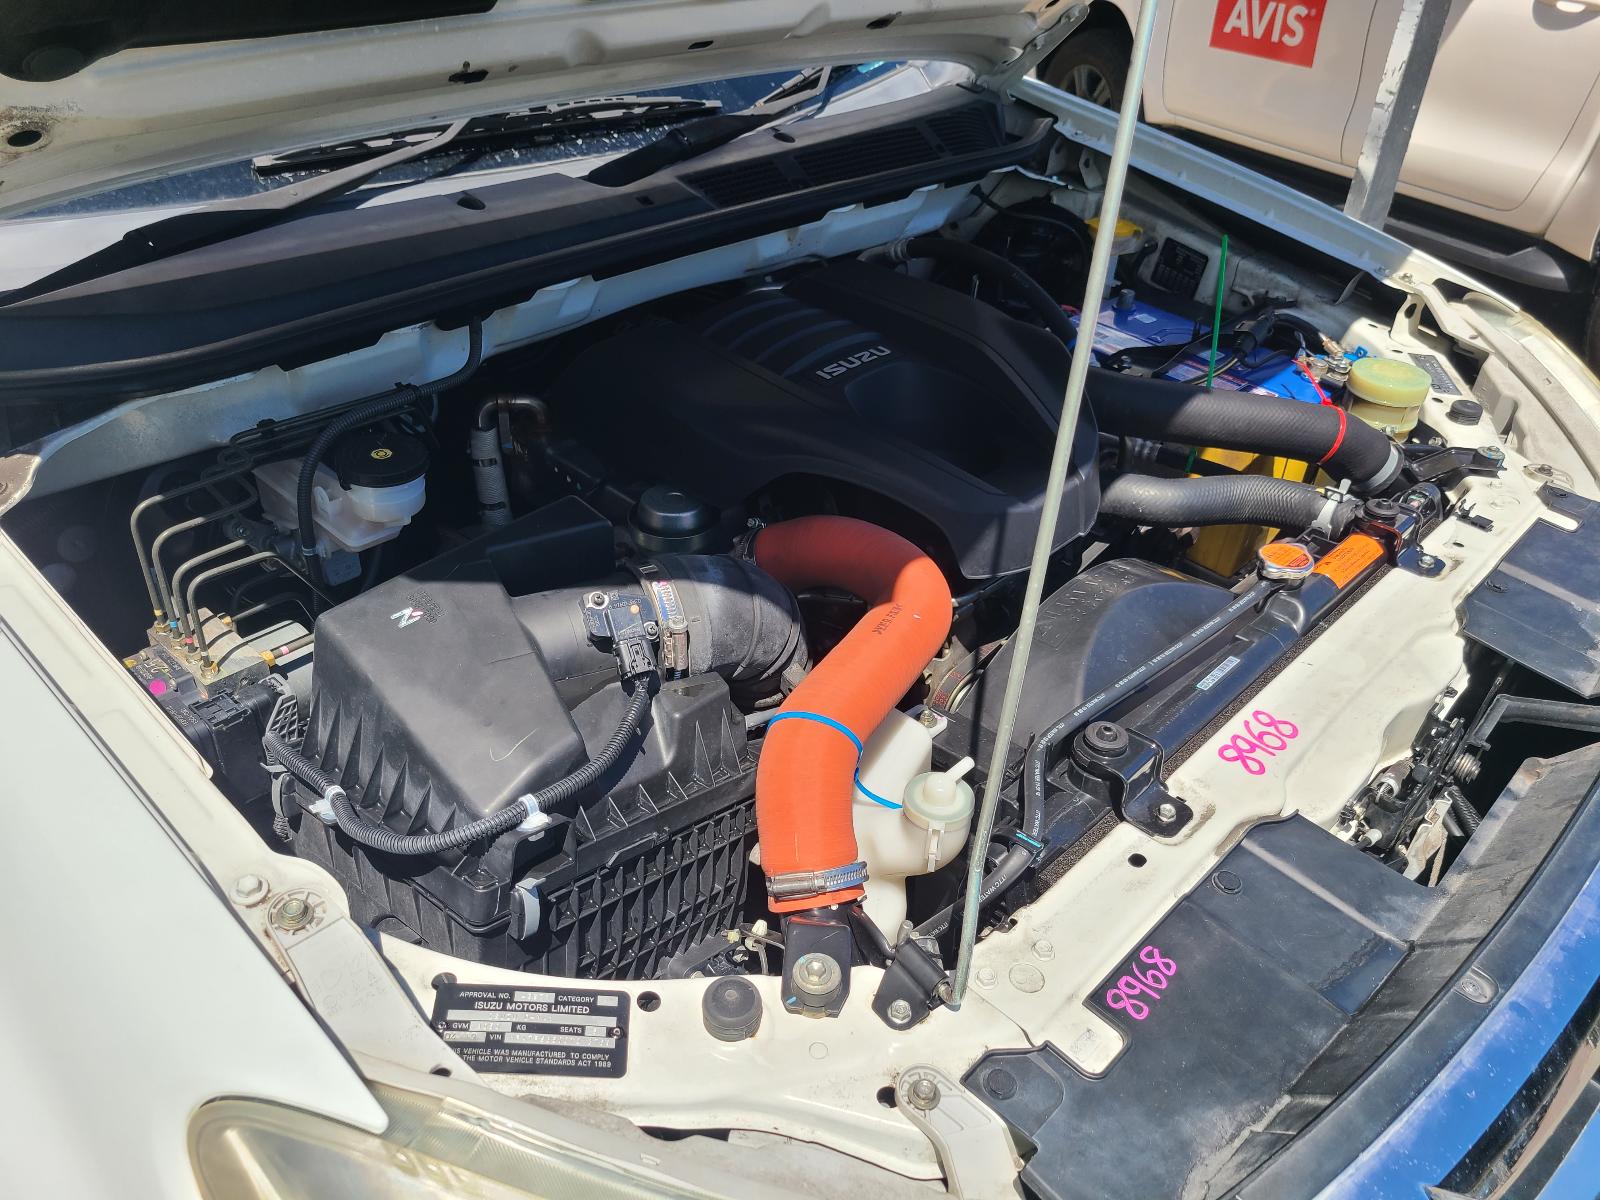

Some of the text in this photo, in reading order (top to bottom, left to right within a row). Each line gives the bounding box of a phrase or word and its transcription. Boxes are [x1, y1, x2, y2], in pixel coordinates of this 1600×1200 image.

[1222, 0, 1305, 48] AVIS
[815, 345, 892, 380] ISUZU
[1217, 709, 1300, 776] 8968
[1105, 944, 1178, 1021] 8968
[459, 991, 497, 999] APPROVAL
[558, 995, 595, 1003] CATEGORY
[474, 1001, 590, 1014] ISUZU MOTORS LIMITED
[560, 1026, 582, 1034] SEATS
[462, 1054, 475, 1062] THE
[478, 1055, 503, 1063] MOTOR
[505, 1056, 534, 1064] VEHICLE
[535, 1057, 576, 1066] STANDARDS
[577, 1060, 591, 1068] ACT
[463, 1047, 492, 1055] VEHICLE
[494, 1048, 510, 1056] WAS
[511, 1049, 566, 1059] MANUFACTURED
[582, 1053, 610, 1061] COMPLY
